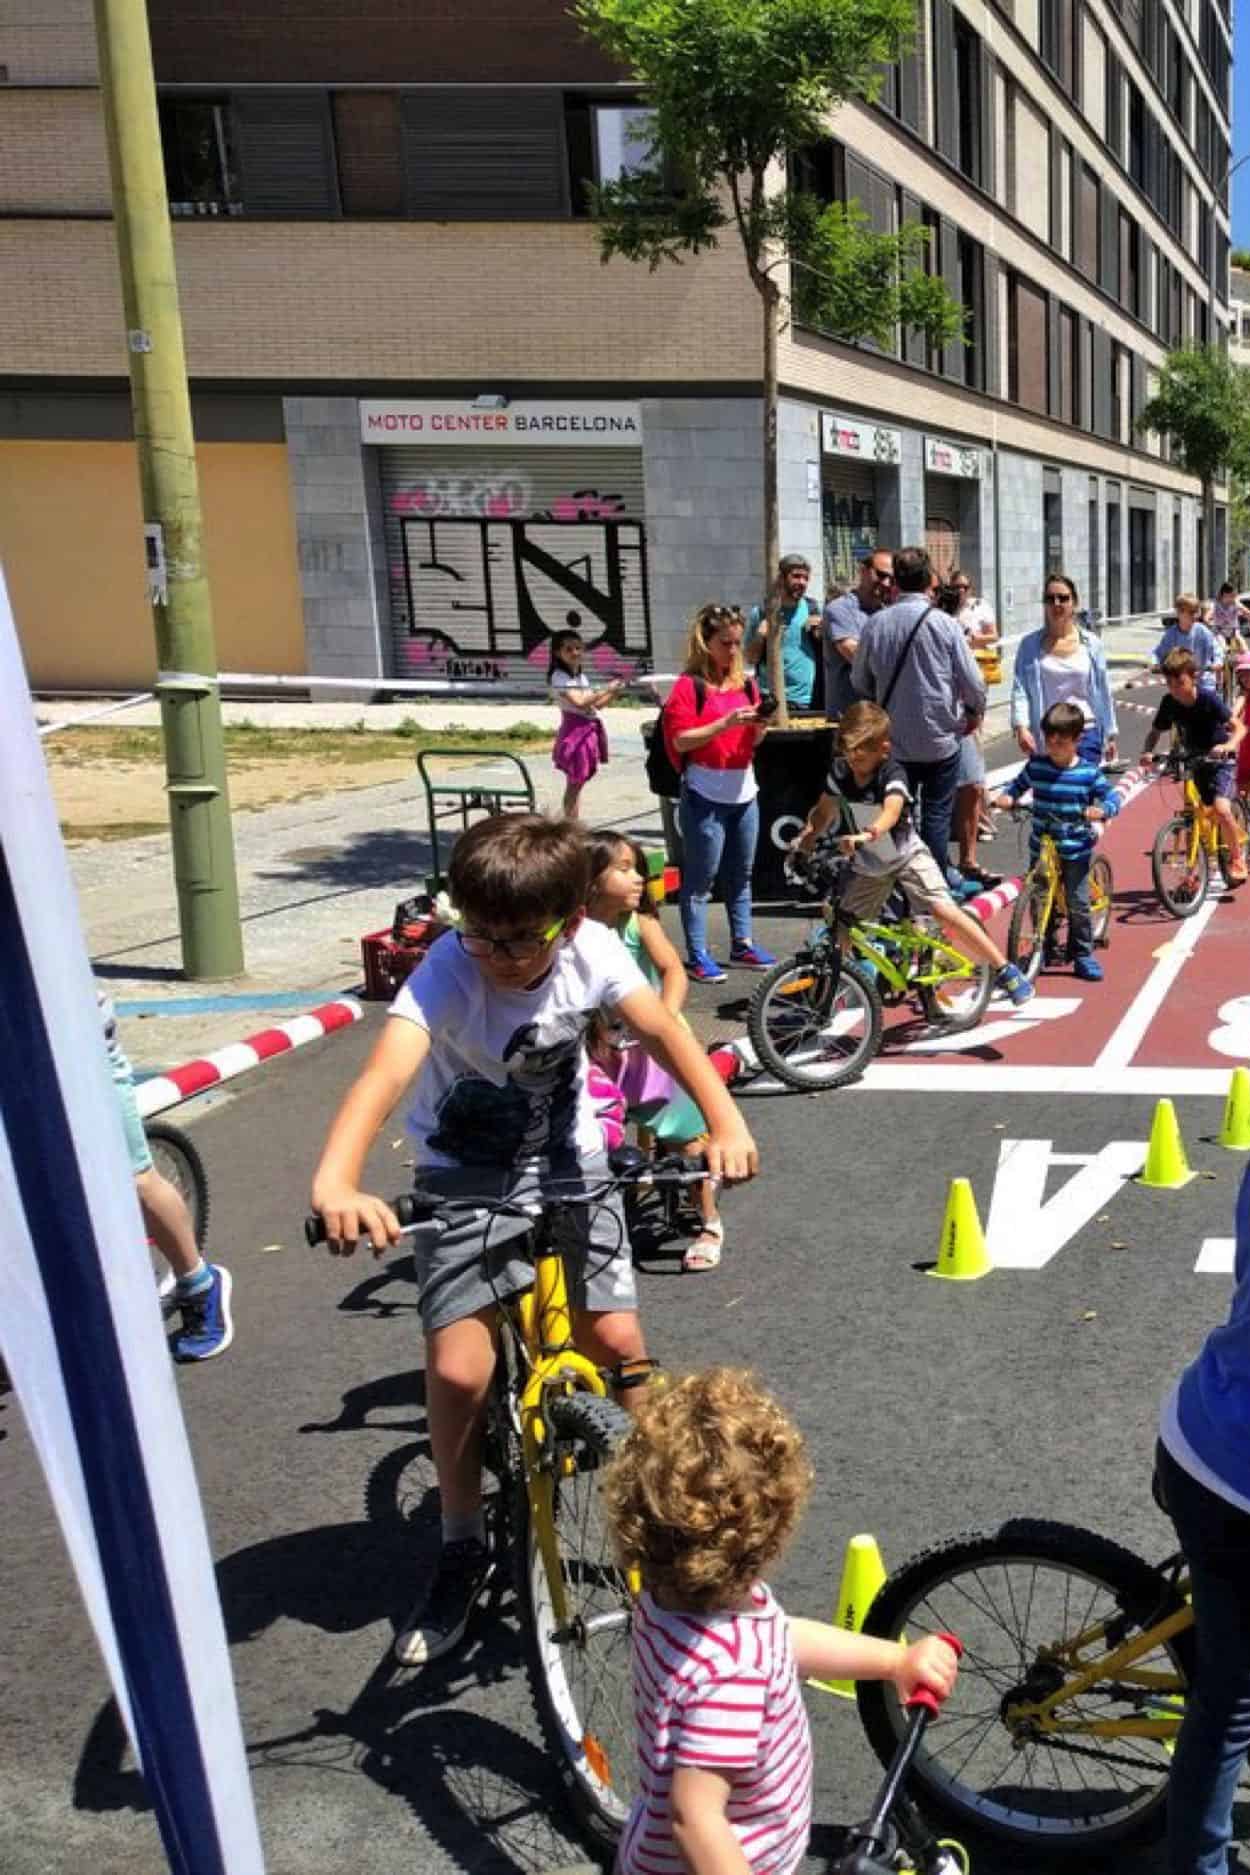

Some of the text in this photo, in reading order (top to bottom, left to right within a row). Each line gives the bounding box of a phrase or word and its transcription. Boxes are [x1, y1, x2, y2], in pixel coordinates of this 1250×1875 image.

[368, 414, 637, 431] MOTO CENTER BARCELONA
